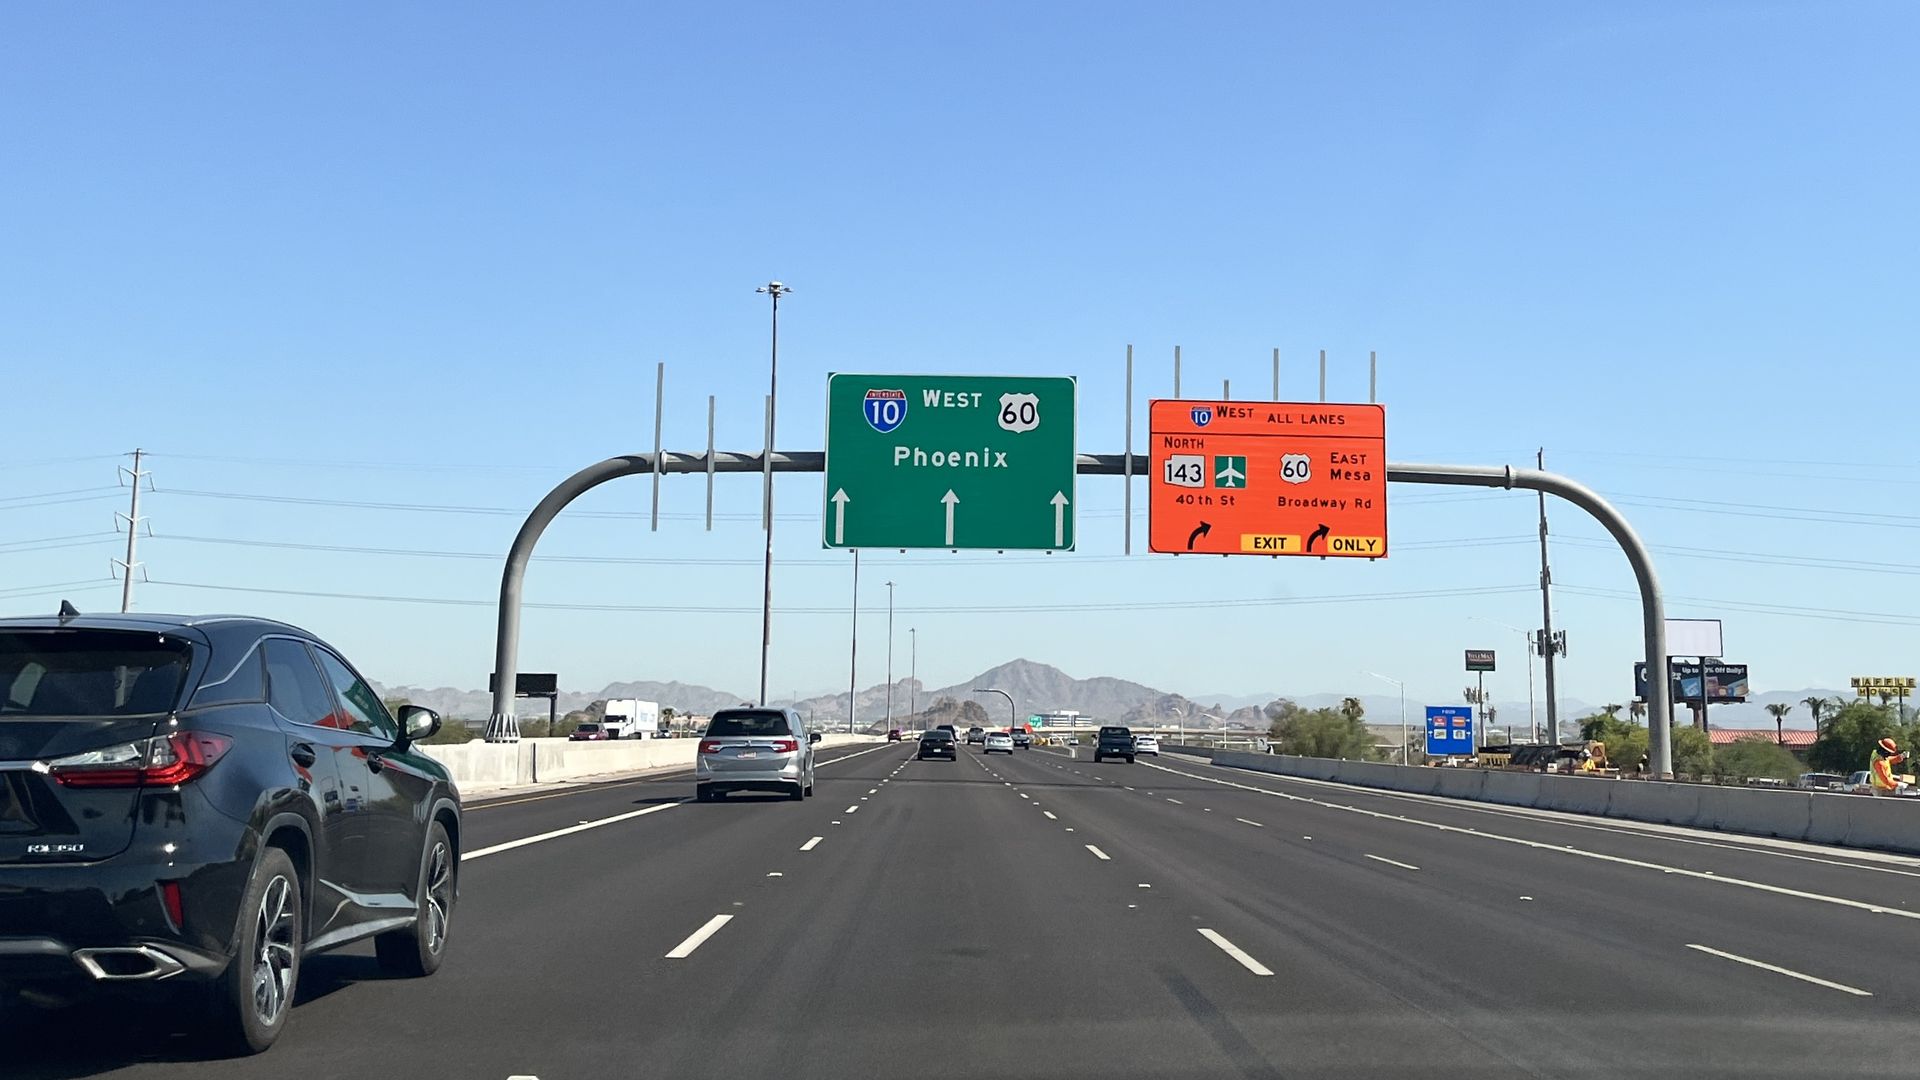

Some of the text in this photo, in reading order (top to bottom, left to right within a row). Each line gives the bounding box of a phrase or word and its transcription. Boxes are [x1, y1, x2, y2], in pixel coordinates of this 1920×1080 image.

[923, 389, 983, 408] WEST
[872, 401, 899, 425] 10
[1002, 402, 1036, 424] 60
[1194, 411, 1209, 424] 10
[1216, 405, 1254, 418] WEST
[1267, 413, 1345, 425] ALL LANES
[1164, 437, 1204, 449] NORTH
[894, 446, 1008, 468] Phoenix
[1331, 452, 1367, 465] EAST
[1167, 463, 1202, 483] 143
[1283, 460, 1308, 478] 60
[1330, 468, 1371, 482] Mesa
[1175, 494, 1235, 506] 40th St
[1278, 496, 1372, 510] Broadway Rd
[1254, 537, 1287, 550] EXIT
[1333, 538, 1376, 552] ONLY
[1852, 678, 1915, 686] WAFFLE
